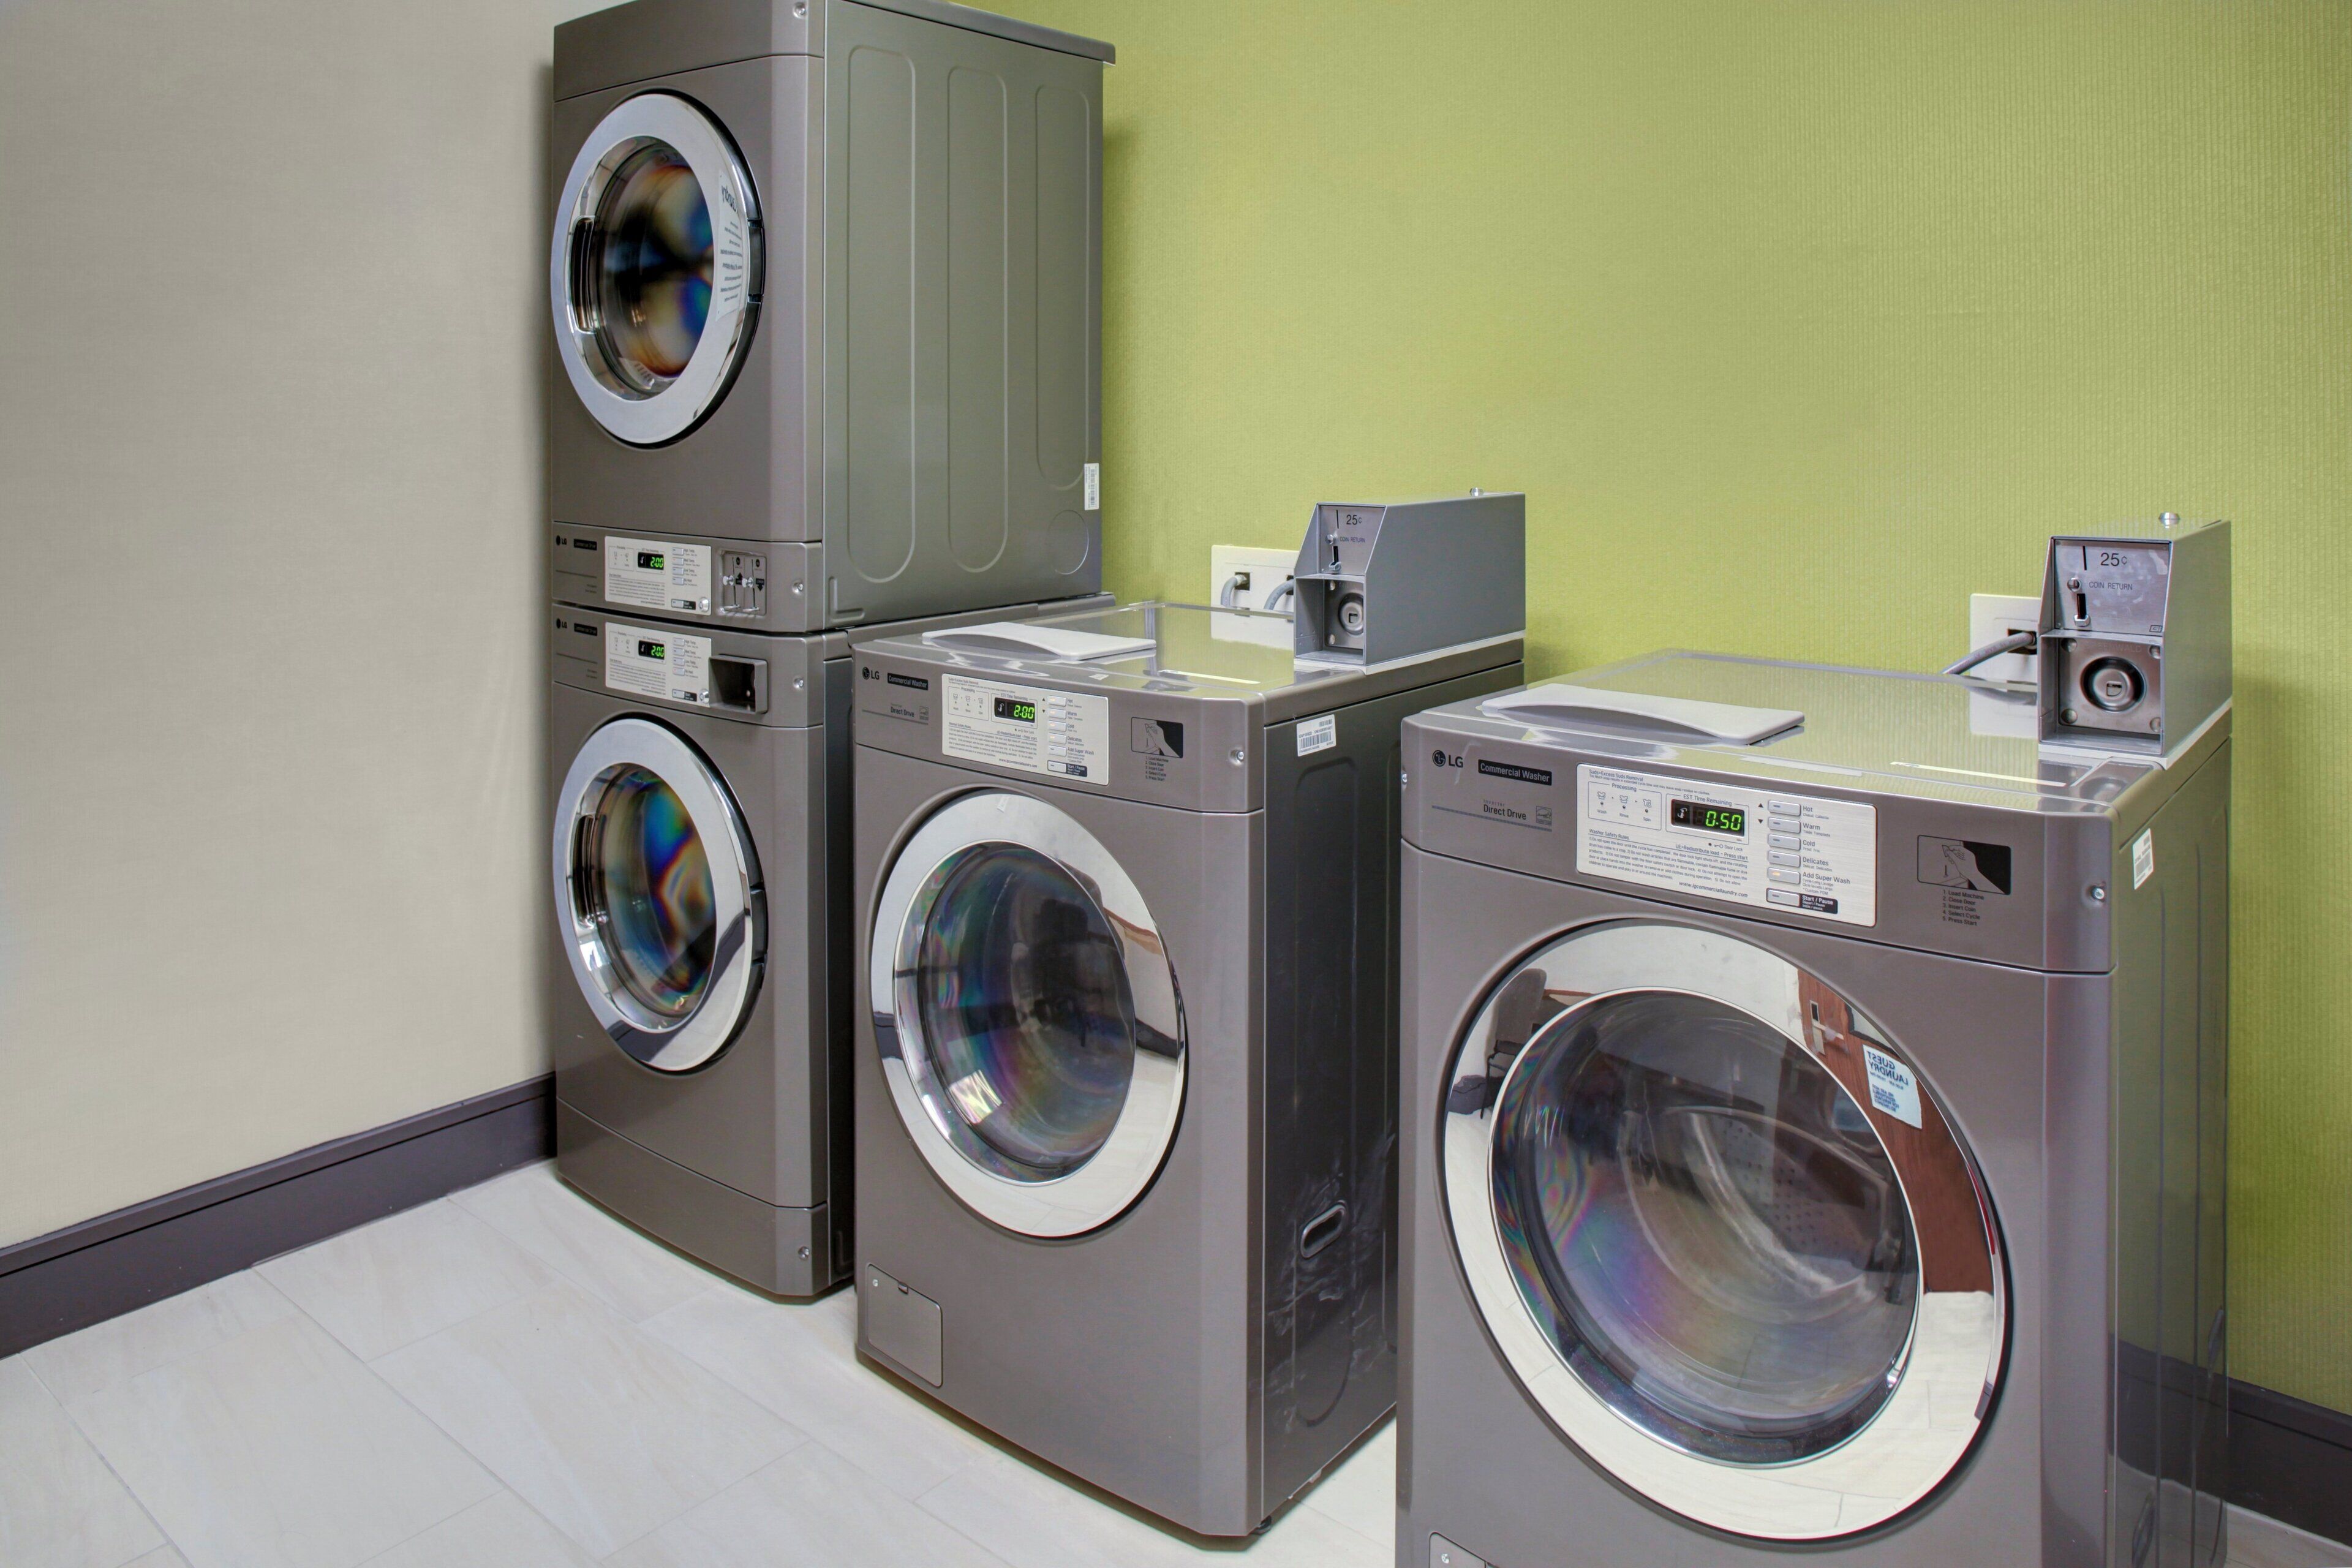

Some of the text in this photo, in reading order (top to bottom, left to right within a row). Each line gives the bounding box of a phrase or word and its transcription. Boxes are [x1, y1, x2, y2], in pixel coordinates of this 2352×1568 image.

[1346, 514, 1362, 526] 25¢
[2100, 552, 2128, 566] 25¢
[871, 670, 880, 680] LG
[889, 676, 927, 688] Commercial Washer
[891, 706, 903, 715] Direct
[1449, 755, 1463, 767] LG
[1480, 763, 1550, 782] Commercial Washer
[1612, 783, 1637, 792] Processing
[1706, 797, 1732, 806] Remaining
[1483, 804, 1526, 820] Direct Drive
[1676, 844, 1709, 854] UE=Redistribute
[1803, 857, 1829, 865] Delicates
[1679, 881, 1748, 897] www.lgcommerciallaundry.com
[1962, 891, 1985, 900] Machine
